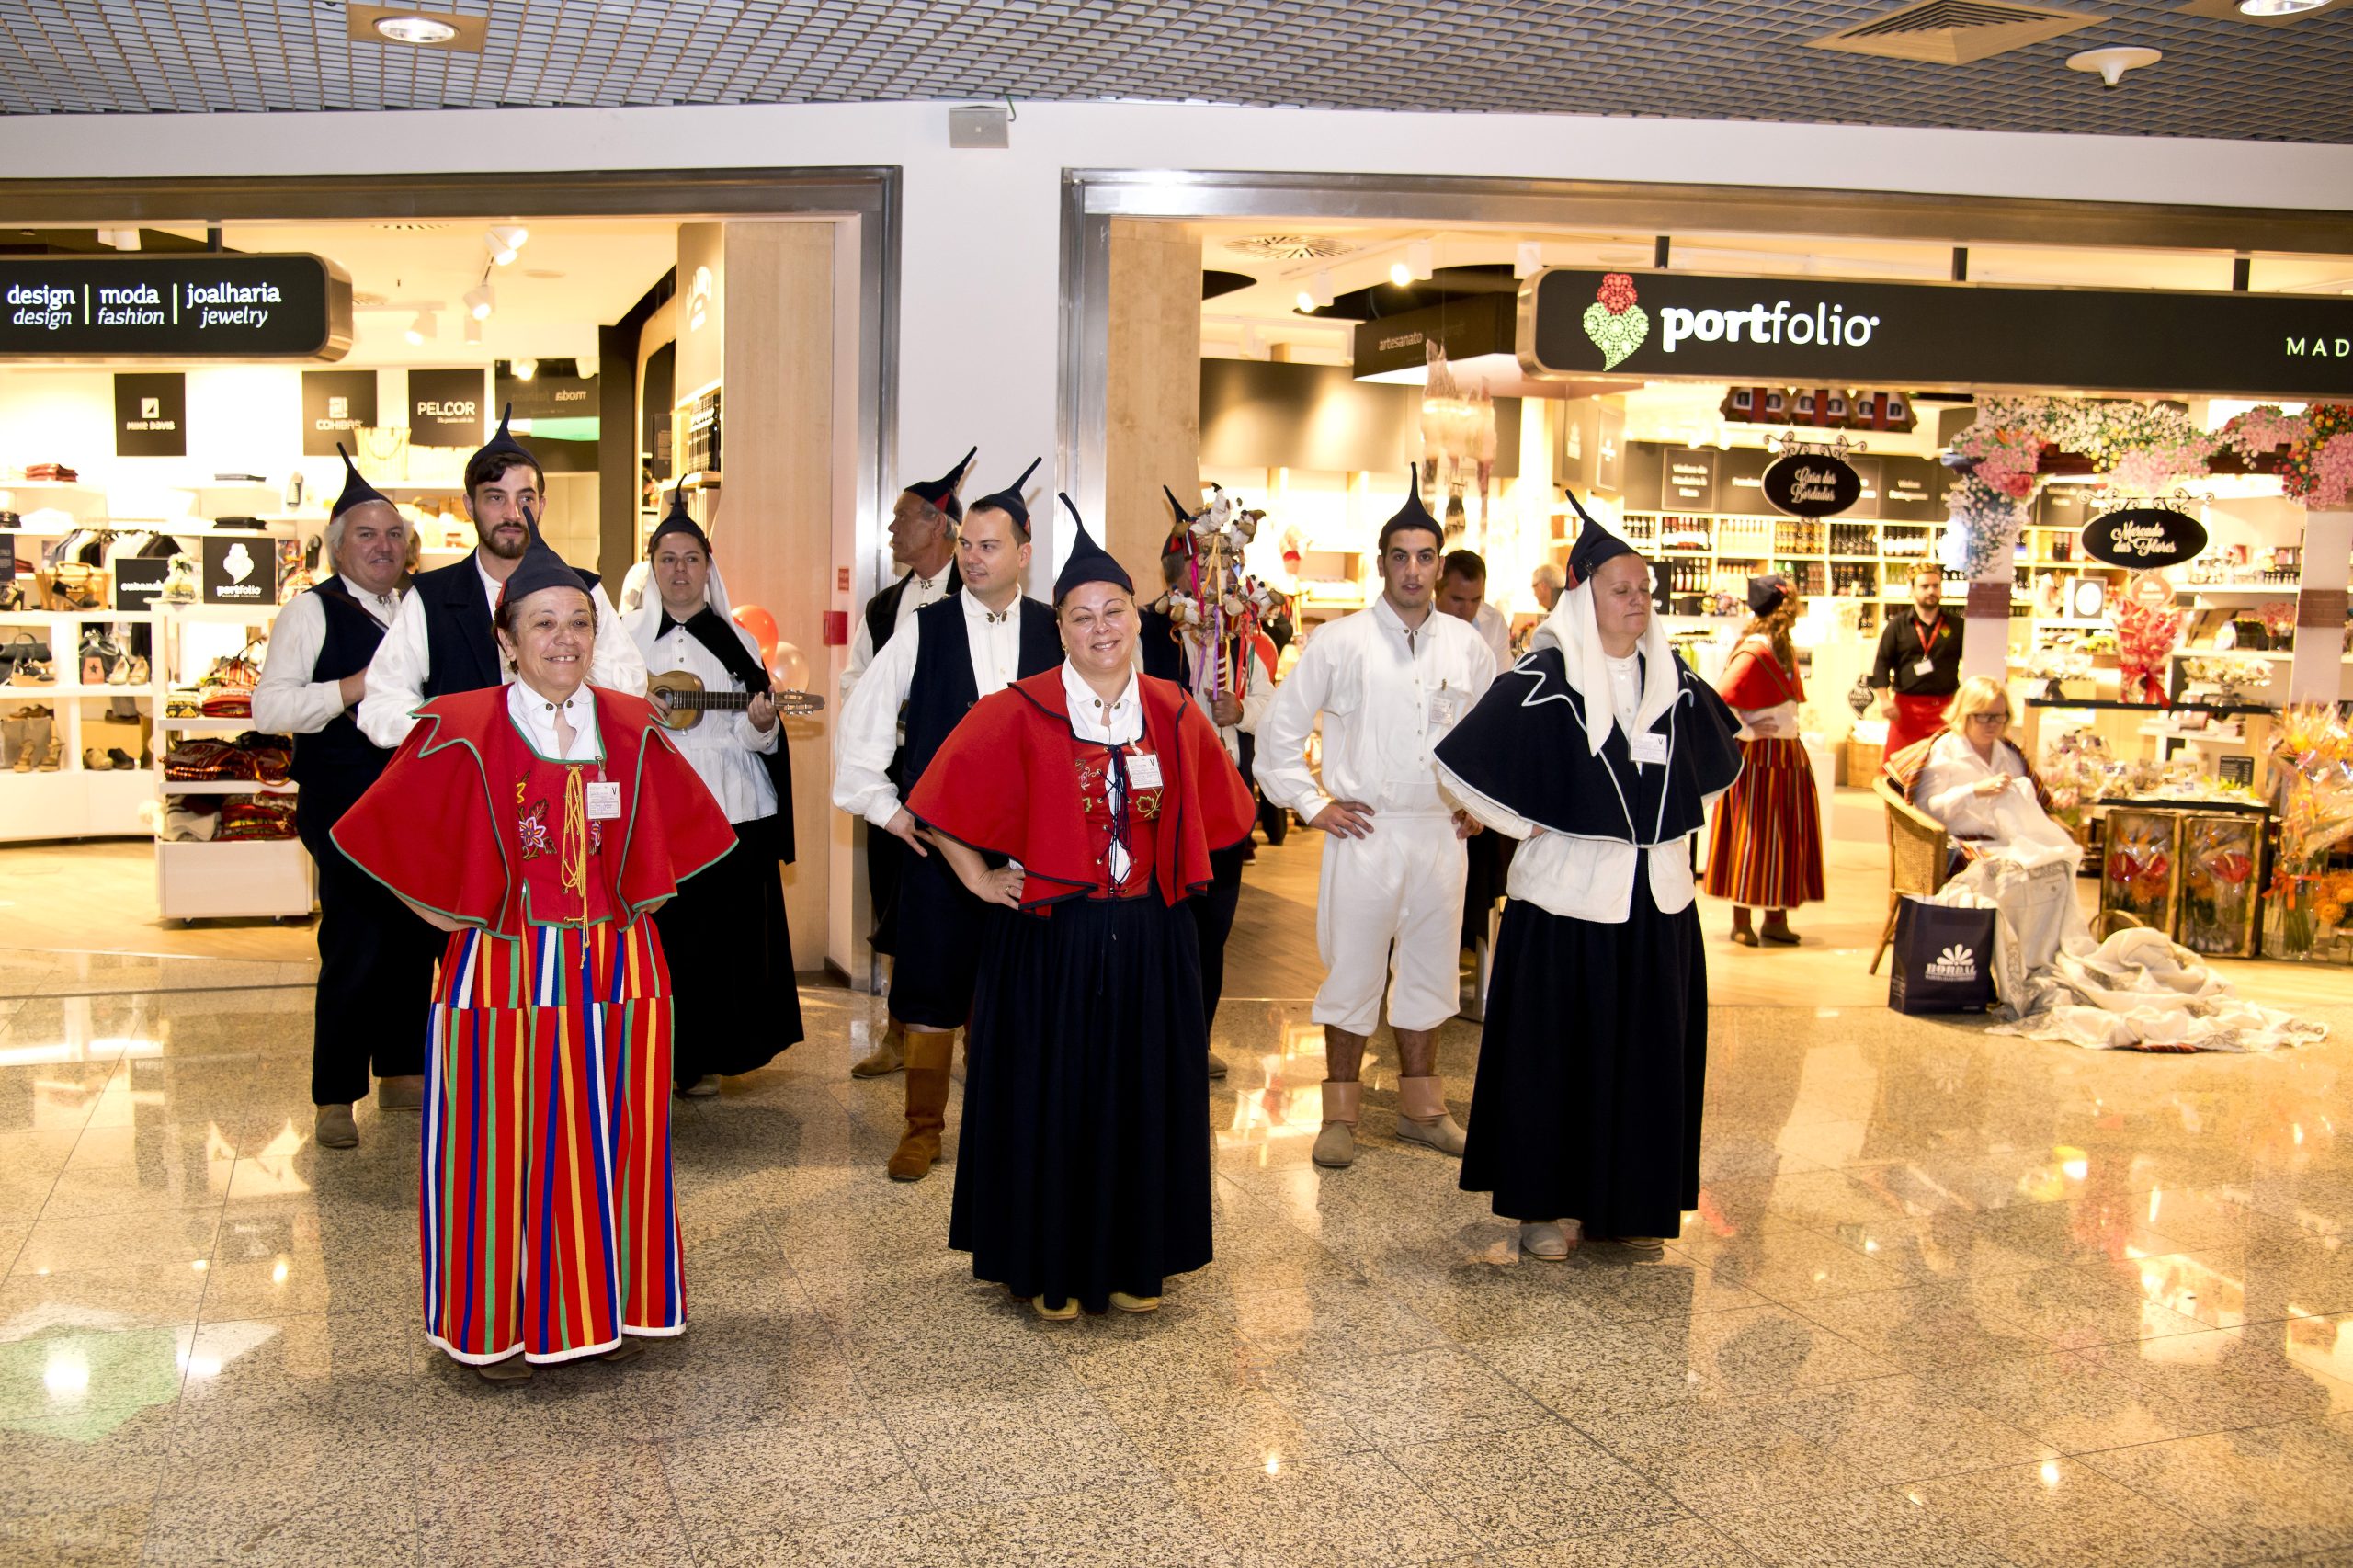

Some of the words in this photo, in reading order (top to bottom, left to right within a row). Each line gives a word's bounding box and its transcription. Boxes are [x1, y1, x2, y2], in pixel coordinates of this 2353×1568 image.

[7, 284, 76, 310] design
[100, 284, 160, 305] moda
[186, 282, 281, 309] joalharia
[13, 307, 73, 329] design
[97, 307, 165, 327] fashion
[199, 306, 268, 328] jewelry
[1660, 301, 1881, 353] portfolio
[1379, 331, 1424, 352] artesanato
[417, 401, 476, 416] PELCOR
[1794, 466, 1820, 487] Casa
[1822, 470, 1837, 485] dos
[1790, 483, 1836, 504] Bordados
[2110, 520, 2165, 544] Mercado
[2133, 538, 2177, 557] Flores
[216, 585, 262, 597] portfolio
[611, 787, 617, 795] V
